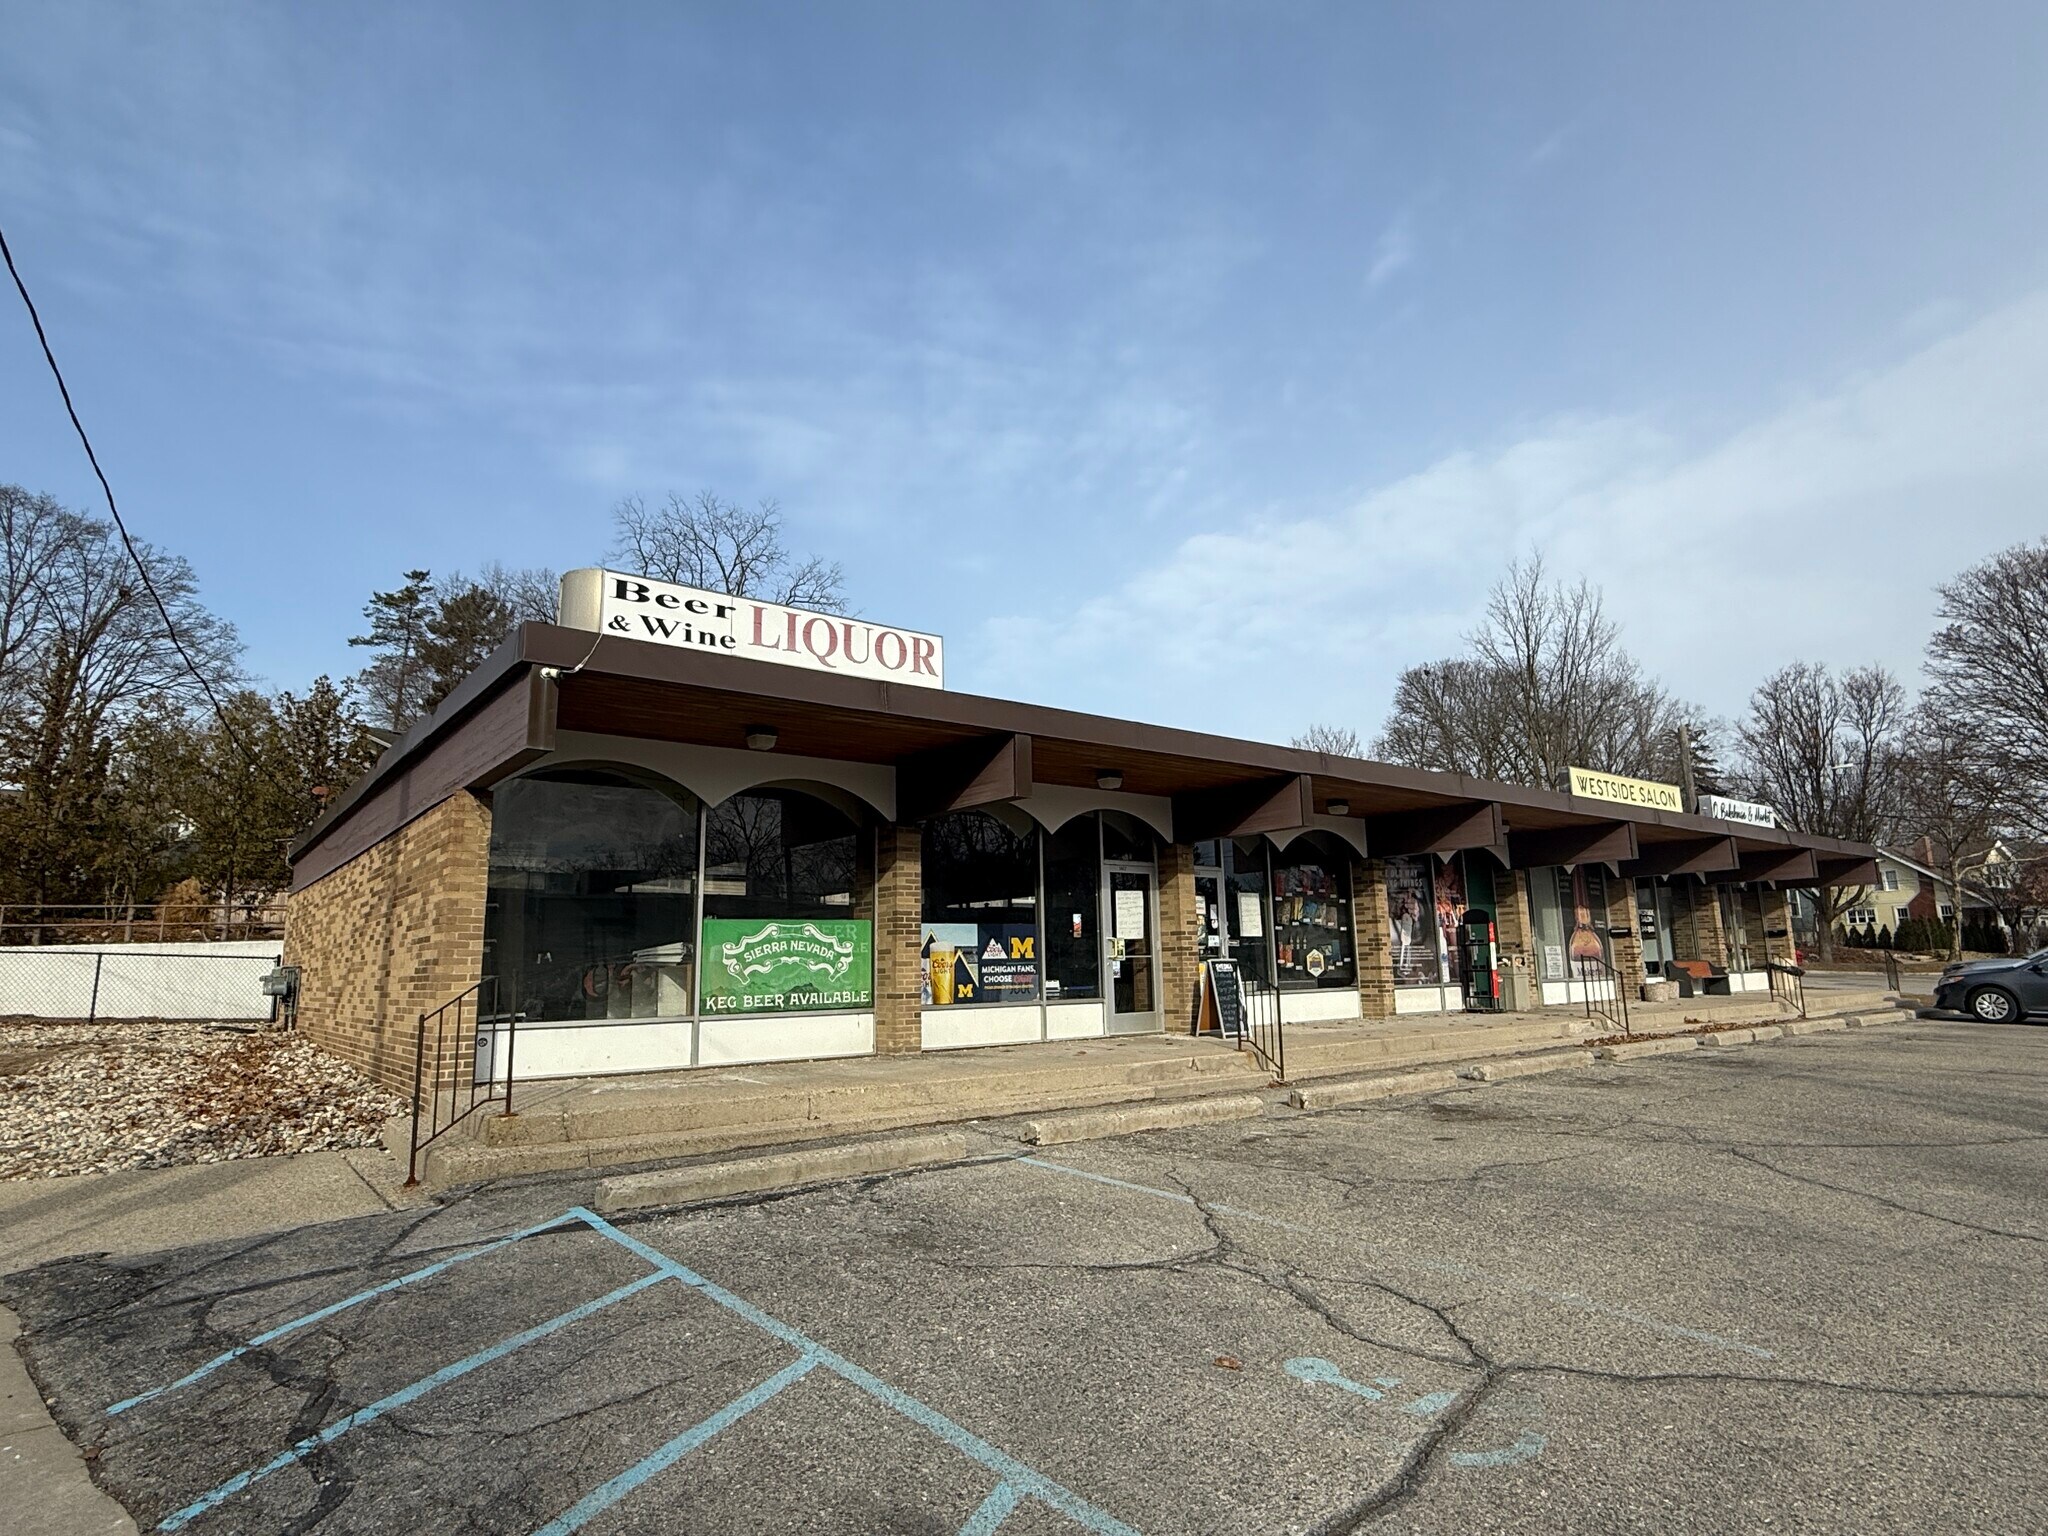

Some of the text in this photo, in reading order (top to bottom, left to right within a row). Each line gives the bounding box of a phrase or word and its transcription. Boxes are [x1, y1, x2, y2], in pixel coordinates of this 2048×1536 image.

[610, 577, 736, 619] Beer
[608, 615, 736, 649] & Wine
[748, 605, 939, 677] LIQUOR
[1576, 775, 1677, 808] WESTSIDE SALON
[743, 940, 788, 962] SIERRA
[790, 940, 835, 960] NEVADA
[1011, 937, 1036, 958] M
[981, 965, 1036, 975] MICHIGAN FANS,
[983, 974, 1013, 983] CHOOSE
[958, 983, 974, 998] M
[706, 991, 869, 1012] KEG BEER AVAILABLE
